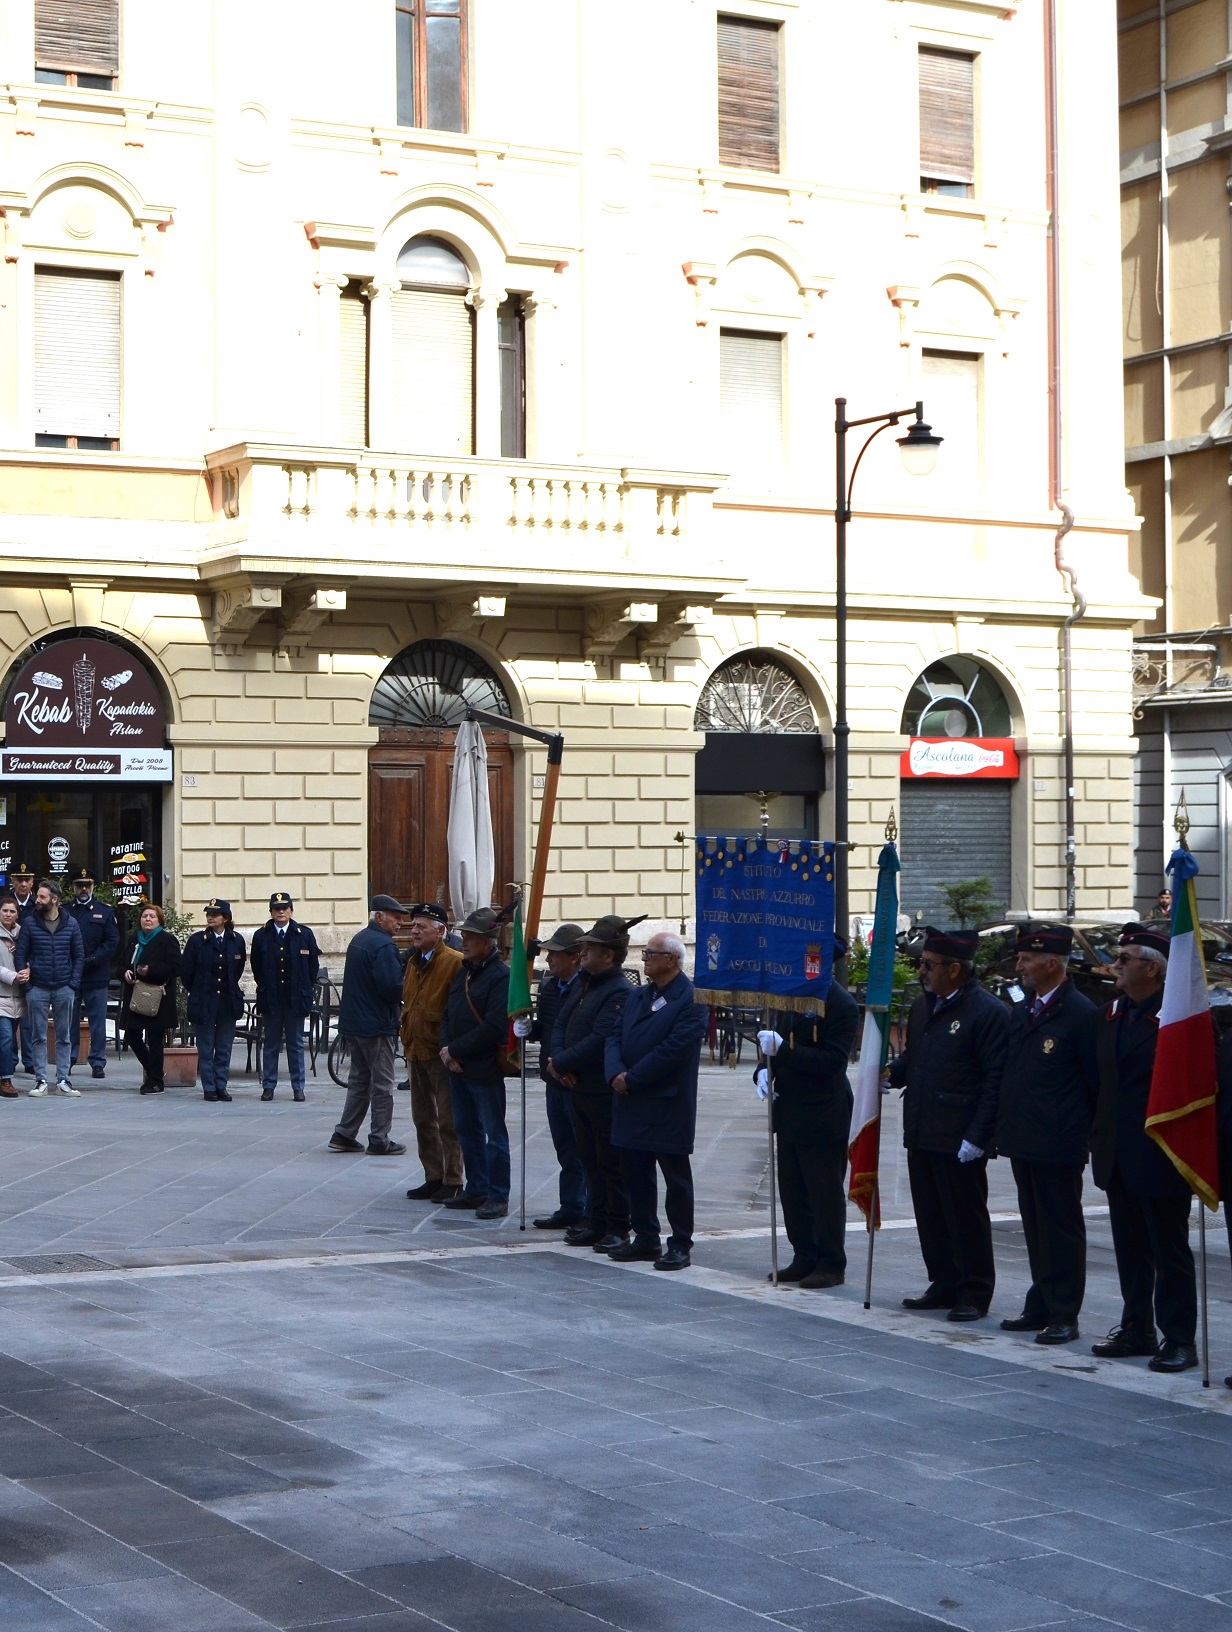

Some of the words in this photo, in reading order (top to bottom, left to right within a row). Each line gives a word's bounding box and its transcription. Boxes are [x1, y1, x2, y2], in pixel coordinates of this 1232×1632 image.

[13, 687, 73, 735] Kebab
[96, 696, 156, 721] Kapadokia
[109, 722, 144, 736] Aslan
[913, 746, 974, 762] Ascolana
[8, 757, 72, 771] Guaranteed
[75, 757, 115, 773] Quality
[185, 776, 196, 785] 83
[111, 841, 144, 855] PATATINE
[113, 866, 126, 875] HOT
[126, 864, 140, 873] DOG
[712, 887, 727, 899] DEL
[770, 890, 815, 907] AZZURRO
[703, 910, 763, 924] FEDERAZIONE
[765, 913, 825, 932] PROVINCIALE
[759, 936, 768, 948] DI
[727, 959, 761, 972] ASCOLI
